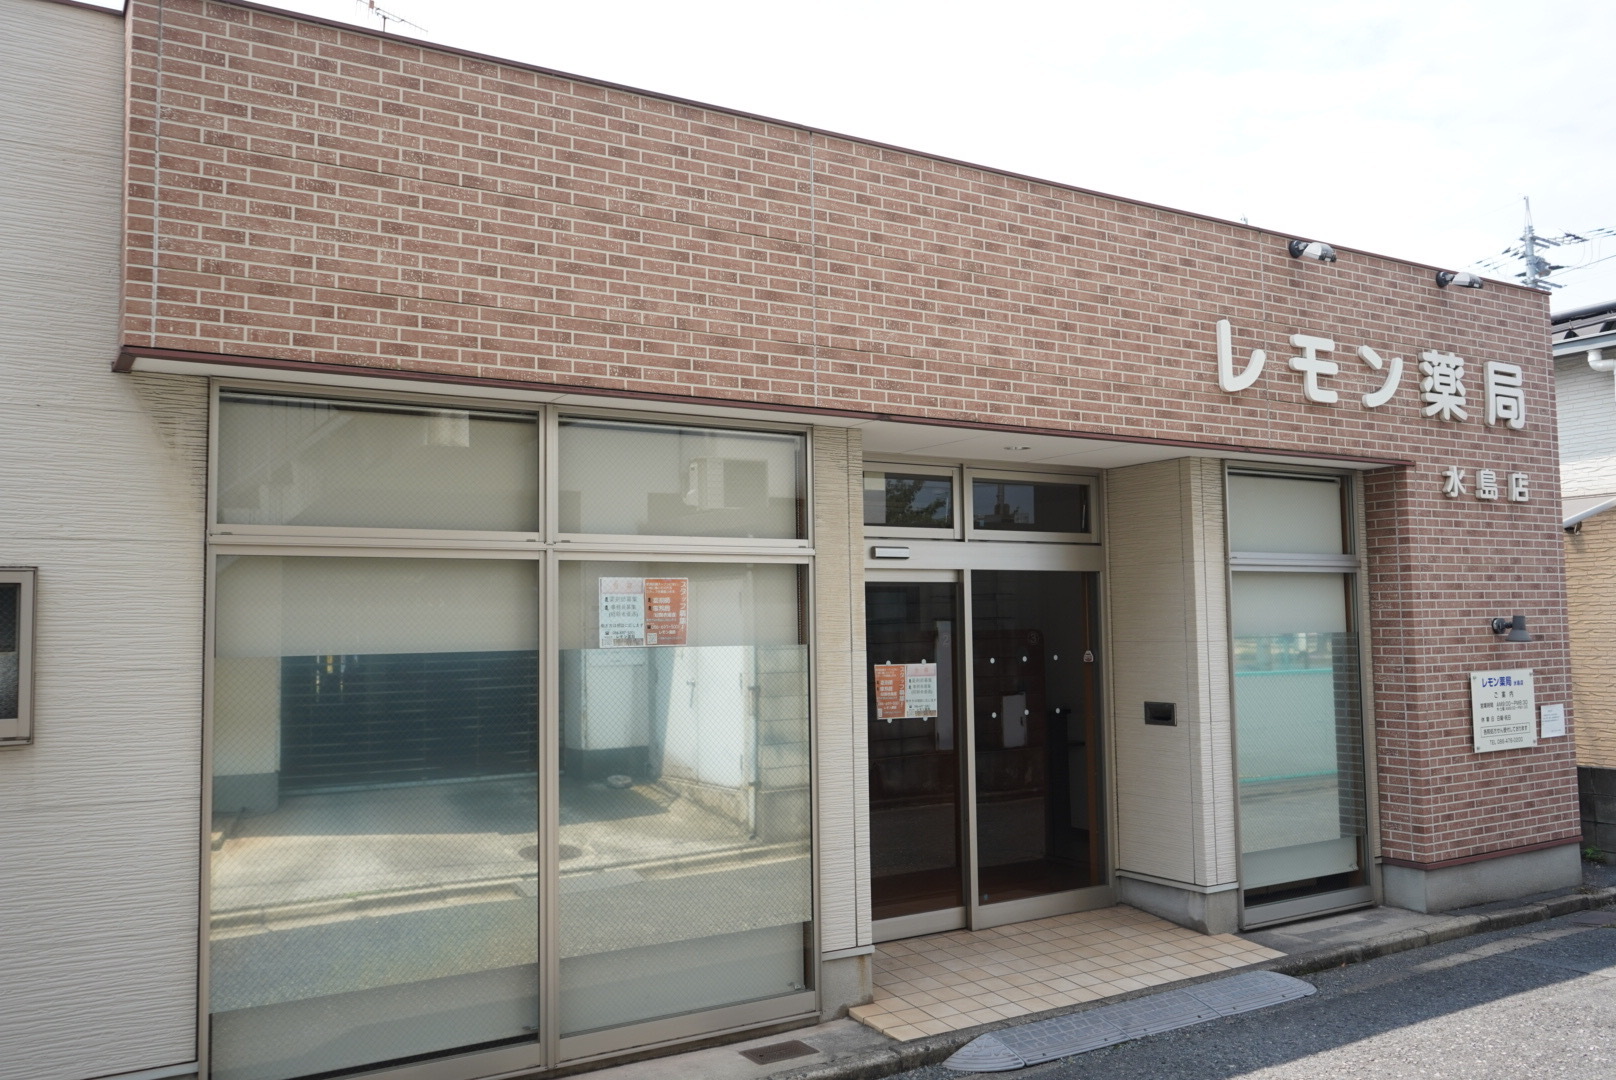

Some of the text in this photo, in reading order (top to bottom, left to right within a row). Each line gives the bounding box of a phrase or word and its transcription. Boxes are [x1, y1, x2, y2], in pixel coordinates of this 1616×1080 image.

[1216, 319, 1526, 430] レモン薬局
[1441, 465, 1529, 502] 水島店
[1482, 676, 1512, 687] レモン薬局
